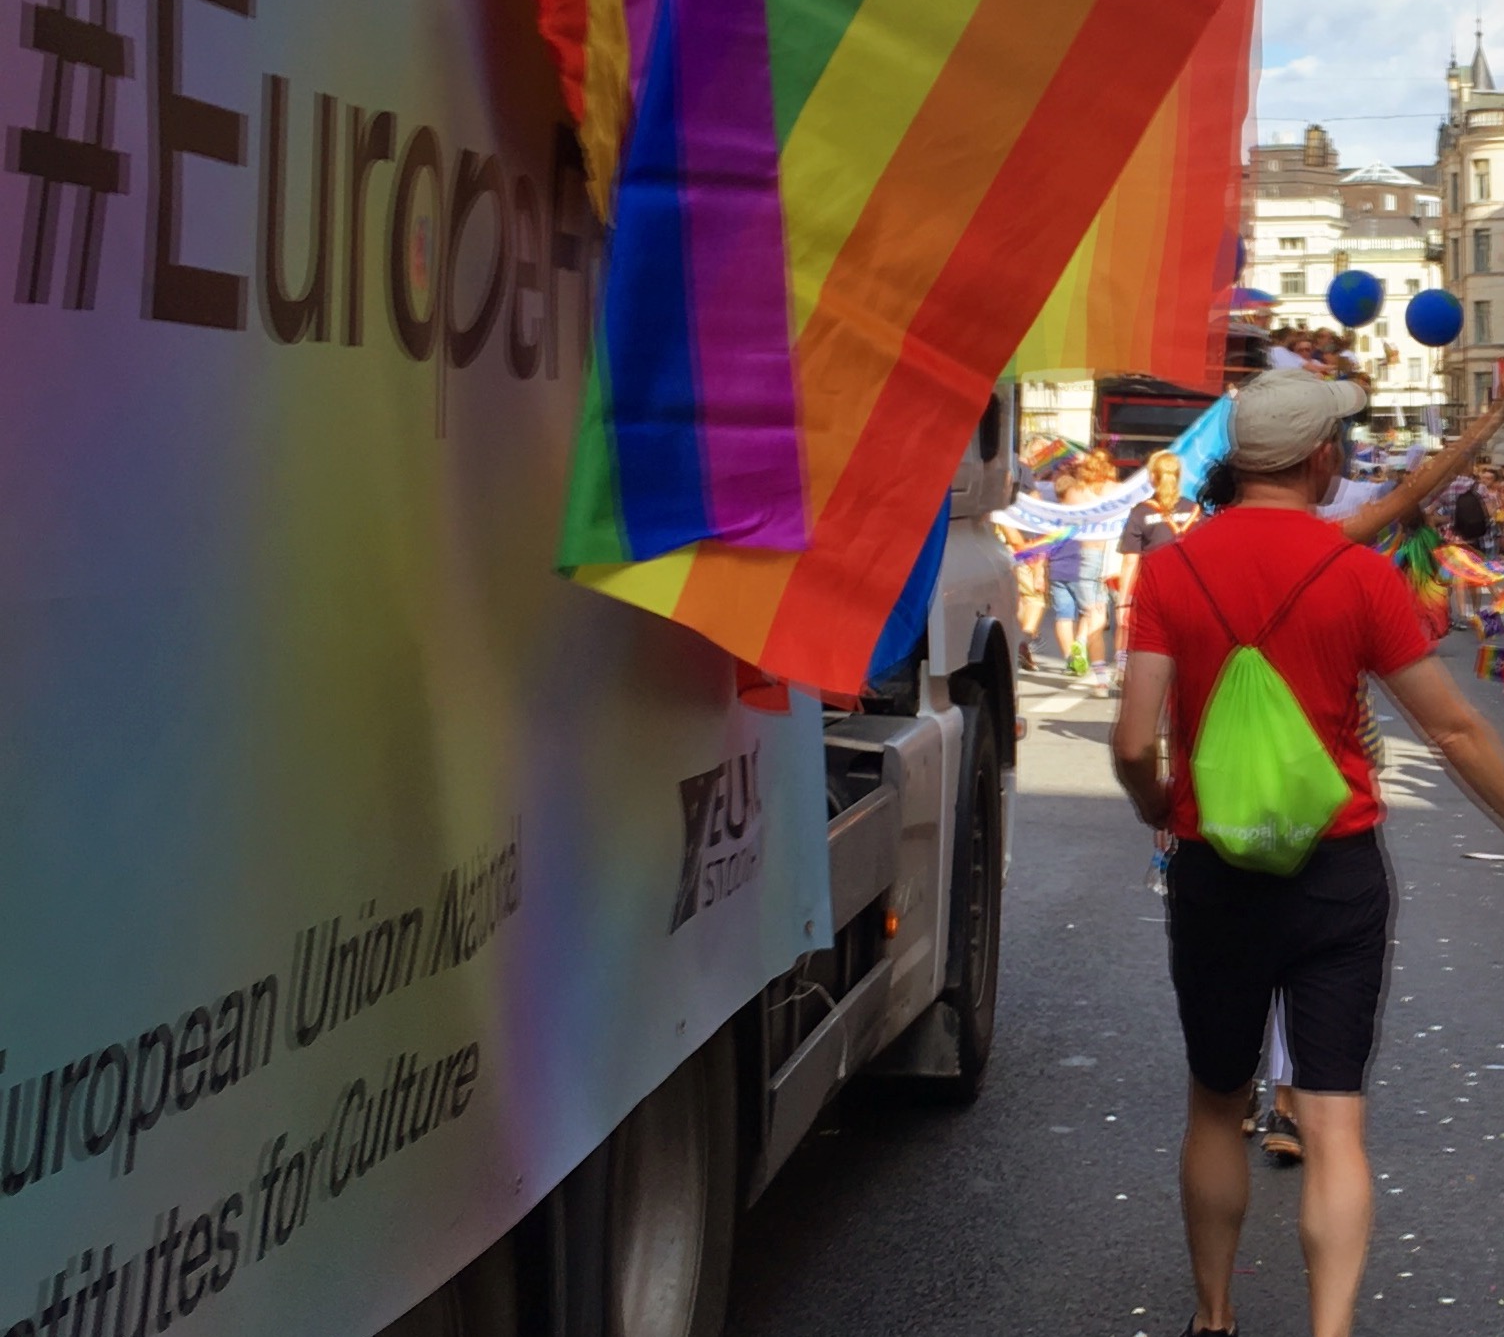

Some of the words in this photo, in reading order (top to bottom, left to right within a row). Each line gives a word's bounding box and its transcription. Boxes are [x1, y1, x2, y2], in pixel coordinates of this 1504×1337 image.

[0, 973, 278, 1196] uropean
[287, 900, 424, 1047] Union
[243, 1131, 327, 1263] for
[326, 1041, 480, 1200] Culture
